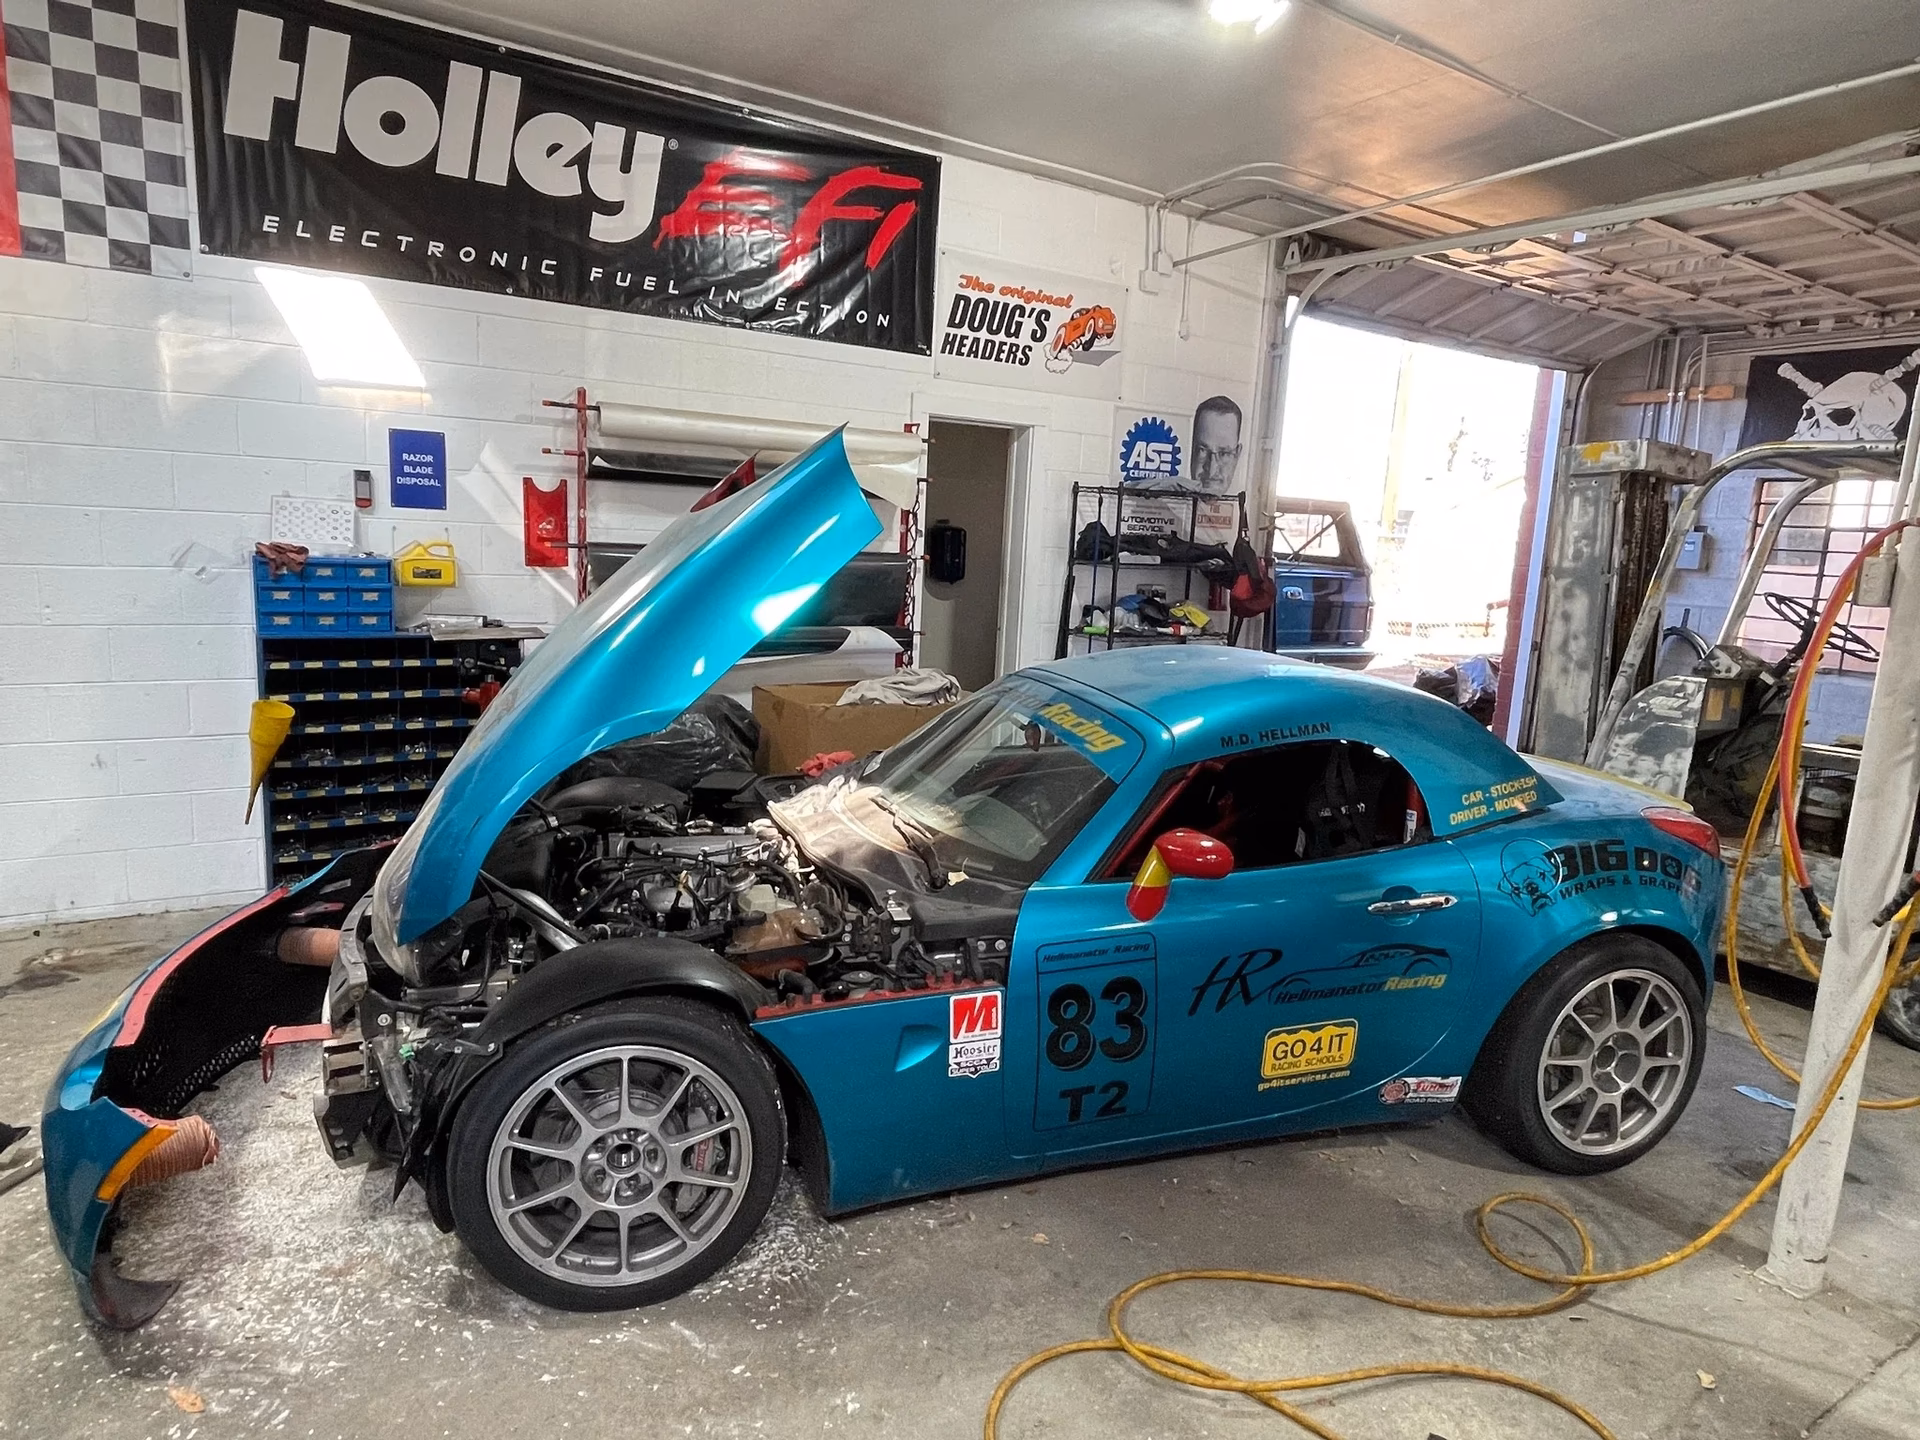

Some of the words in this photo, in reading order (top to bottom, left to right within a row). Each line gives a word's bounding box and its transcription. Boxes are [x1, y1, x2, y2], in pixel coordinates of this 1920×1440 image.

[224, 8, 666, 243] Holley
[652, 145, 924, 289] EFI
[262, 214, 558, 275] ELECTRONIC
[589, 266, 680, 295] FUEL
[708, 286, 890, 327] INECTION
[958, 274, 995, 293] The
[999, 286, 1074, 309] original
[946, 294, 1052, 343] DOUG'S
[940, 332, 1033, 367] HEADERS
[402, 453, 434, 462] RAZOR
[403, 465, 434, 474] BLADE
[1126, 441, 1173, 471] ASE
[396, 476, 441, 487] DISPOSAL
[1121, 516, 1175, 525] UTOMOTIVE
[1127, 524, 1164, 533] SERVICE
[1037, 702, 1127, 753] Racing
[1220, 732, 1255, 748] M.D.
[1258, 721, 1332, 744] HELLMAN
[1449, 804, 1488, 825] DRIVER
[1494, 790, 1538, 812] MODIFIED
[1461, 790, 1484, 806] CAR
[1543, 838, 1629, 883] BIG
[1558, 875, 1616, 900] WRAPS
[1622, 875, 1633, 886] &
[1042, 948, 1110, 963] Hellmanator
[1113, 943, 1151, 954] Racing
[1187, 948, 1284, 1017] HR
[1046, 976, 1149, 1072] 83
[952, 1042, 998, 1060] Hoosier
[1270, 1060, 1302, 1073] RACING
[1304, 1054, 1345, 1067] SCHOOLS
